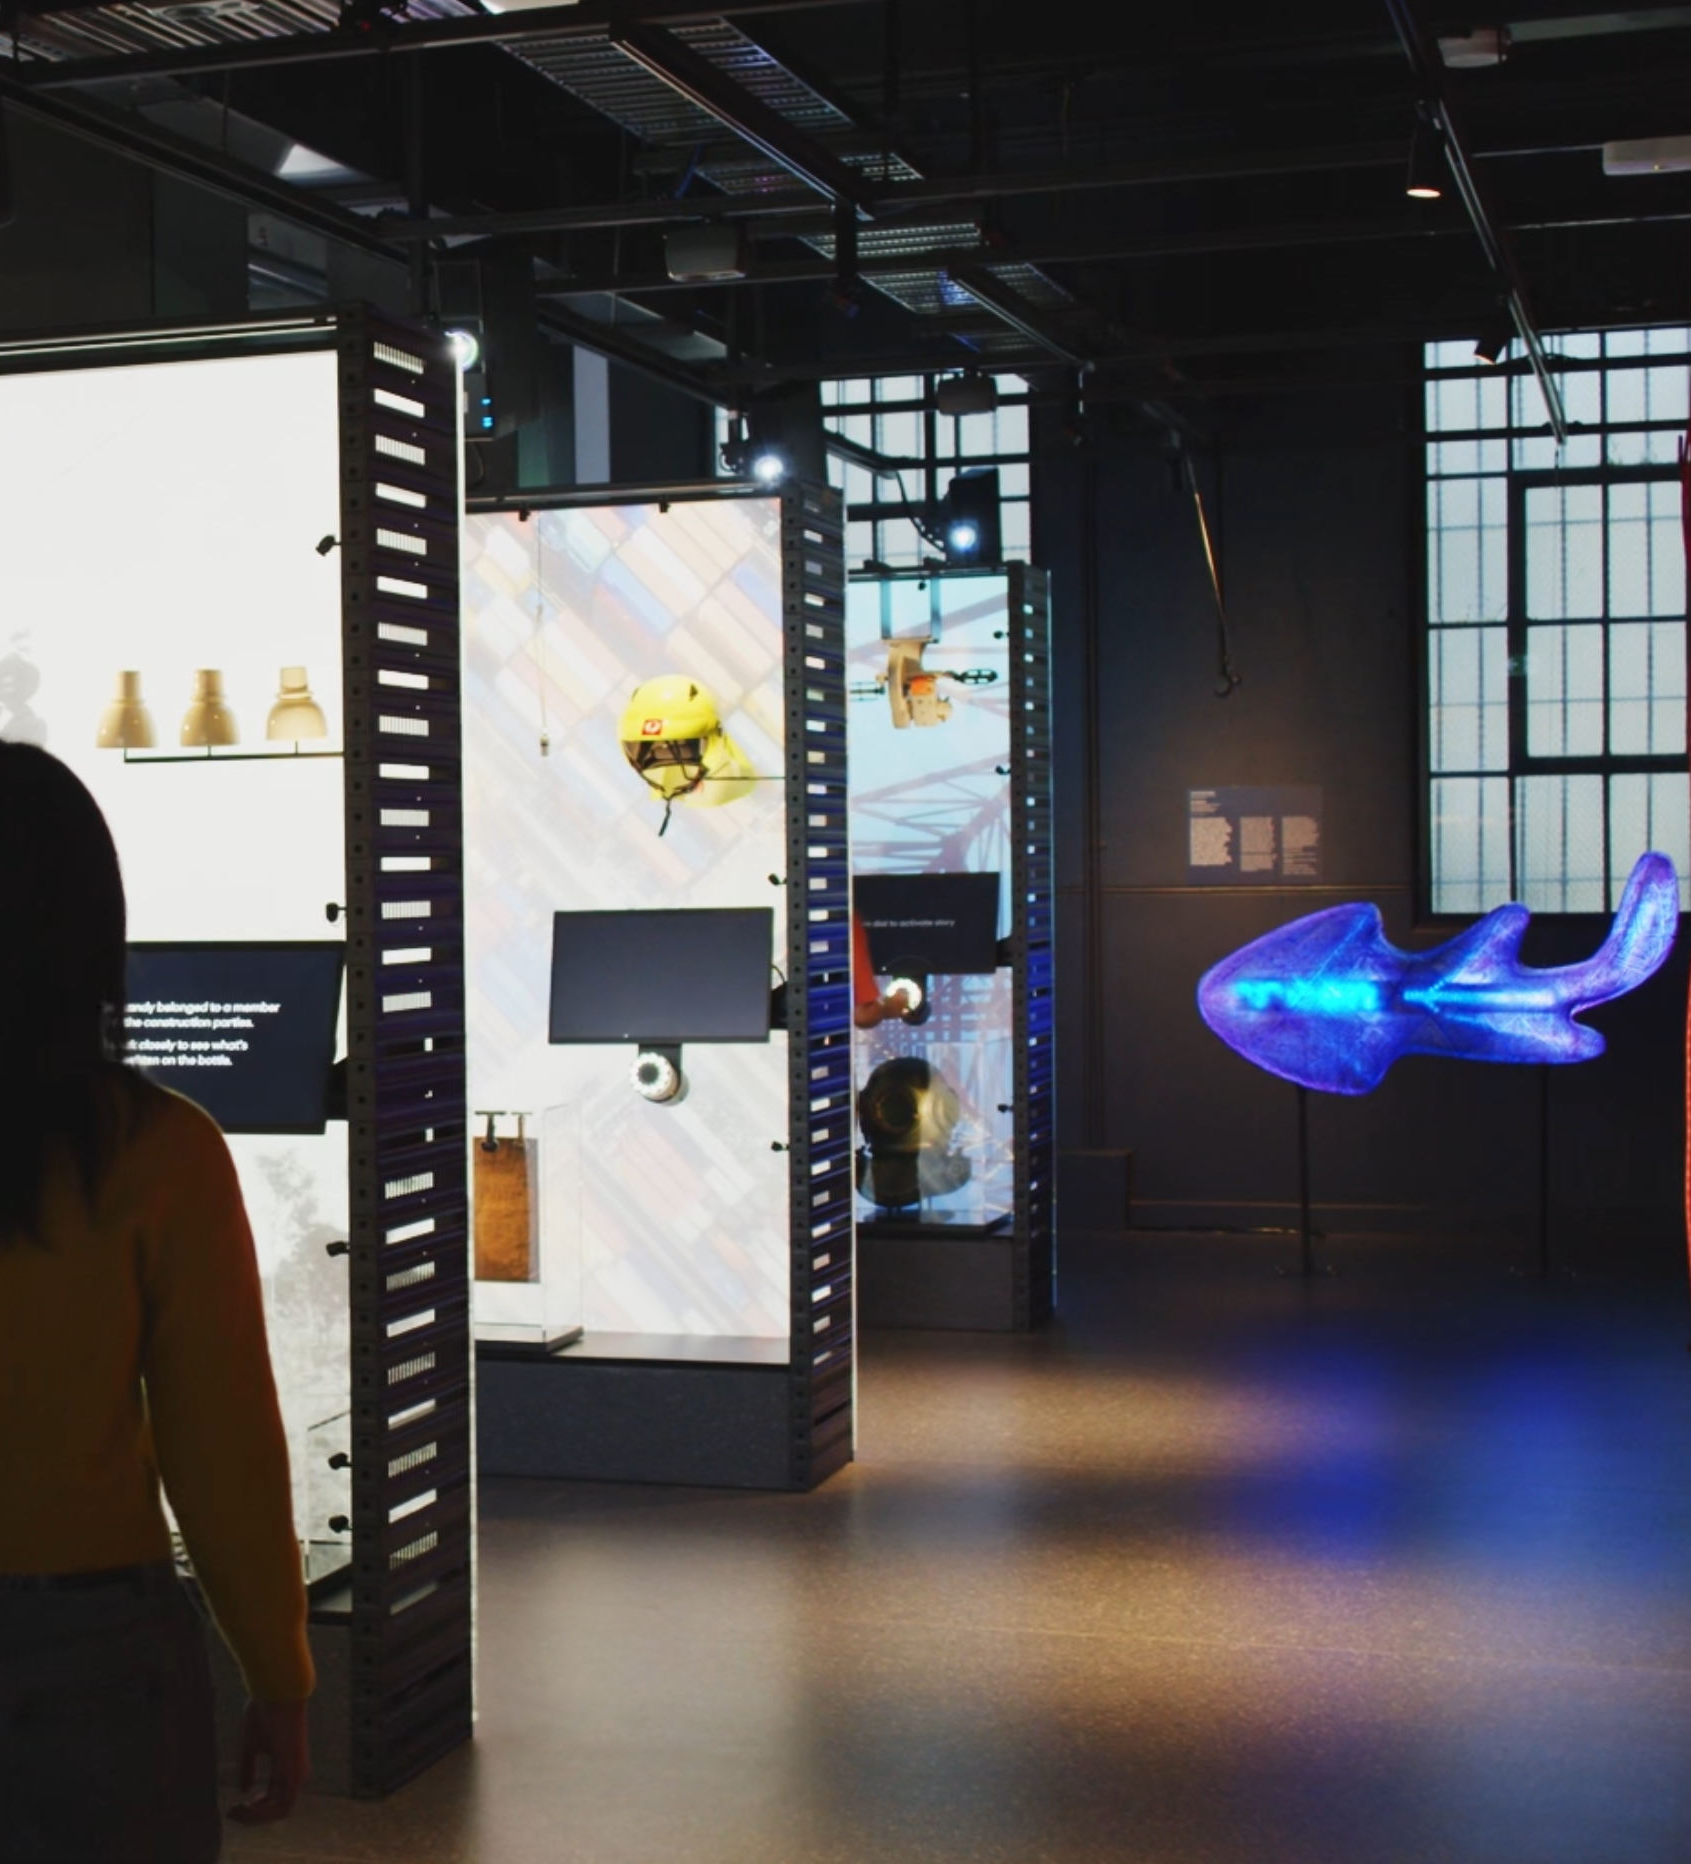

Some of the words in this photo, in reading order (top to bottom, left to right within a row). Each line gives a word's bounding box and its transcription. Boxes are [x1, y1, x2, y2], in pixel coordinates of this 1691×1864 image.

[889, 919, 898, 927] to
[899, 918, 933, 927] activate
[935, 918, 956, 928] story
[156, 1001, 209, 1015] belonged
[209, 1001, 222, 1013] to
[223, 1003, 232, 1013] a
[232, 1001, 282, 1013] member
[123, 1016, 143, 1028] the
[143, 1016, 212, 1028] construction
[212, 1016, 254, 1030] parties.
[138, 1039, 176, 1053] closely
[176, 1039, 189, 1051] to
[190, 1041, 210, 1051] see
[161, 1056, 176, 1066] on
[177, 1054, 196, 1066] the
[197, 1054, 233, 1066] bottle.
